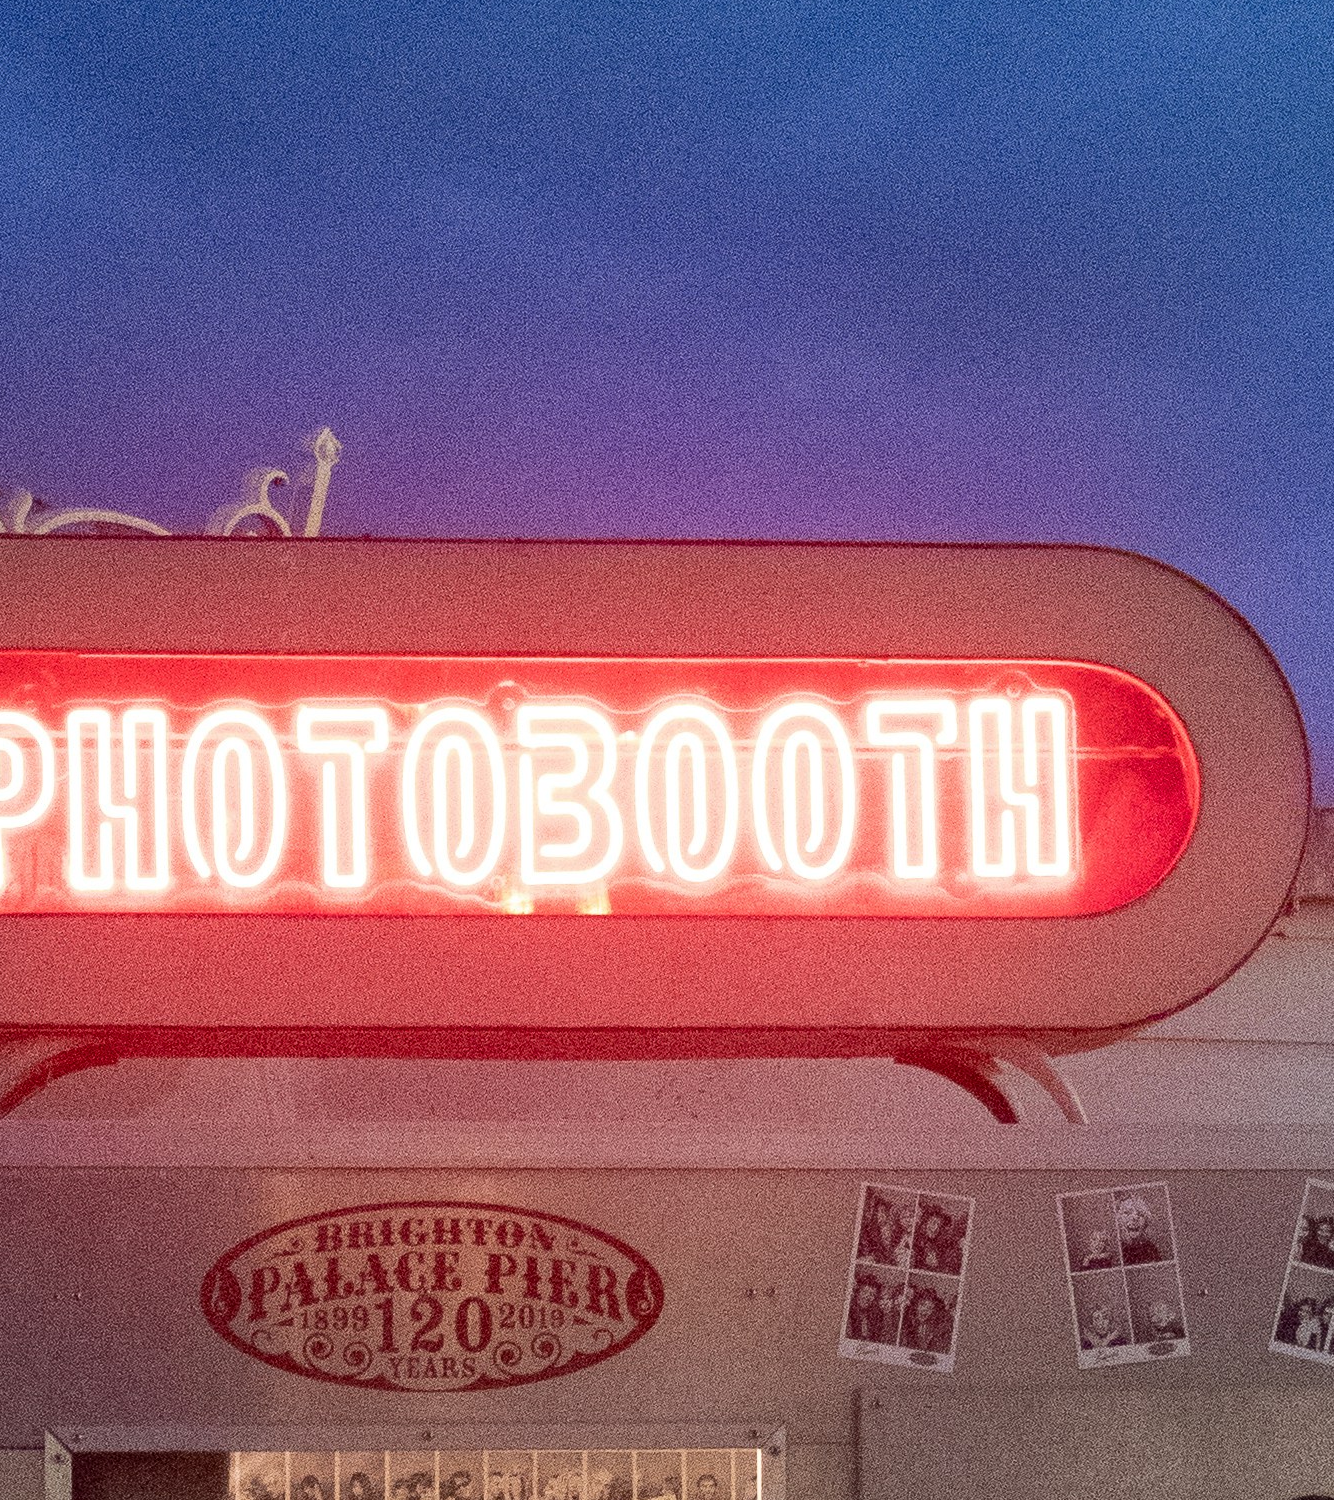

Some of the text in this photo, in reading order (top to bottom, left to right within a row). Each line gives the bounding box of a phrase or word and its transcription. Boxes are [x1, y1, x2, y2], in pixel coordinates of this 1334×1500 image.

[314, 1216, 558, 1253] BRIGHTON
[247, 1251, 624, 1323] PALACE PIER
[299, 1295, 566, 1354] 1899 120 2019
[388, 1356, 478, 1379] YEARS
